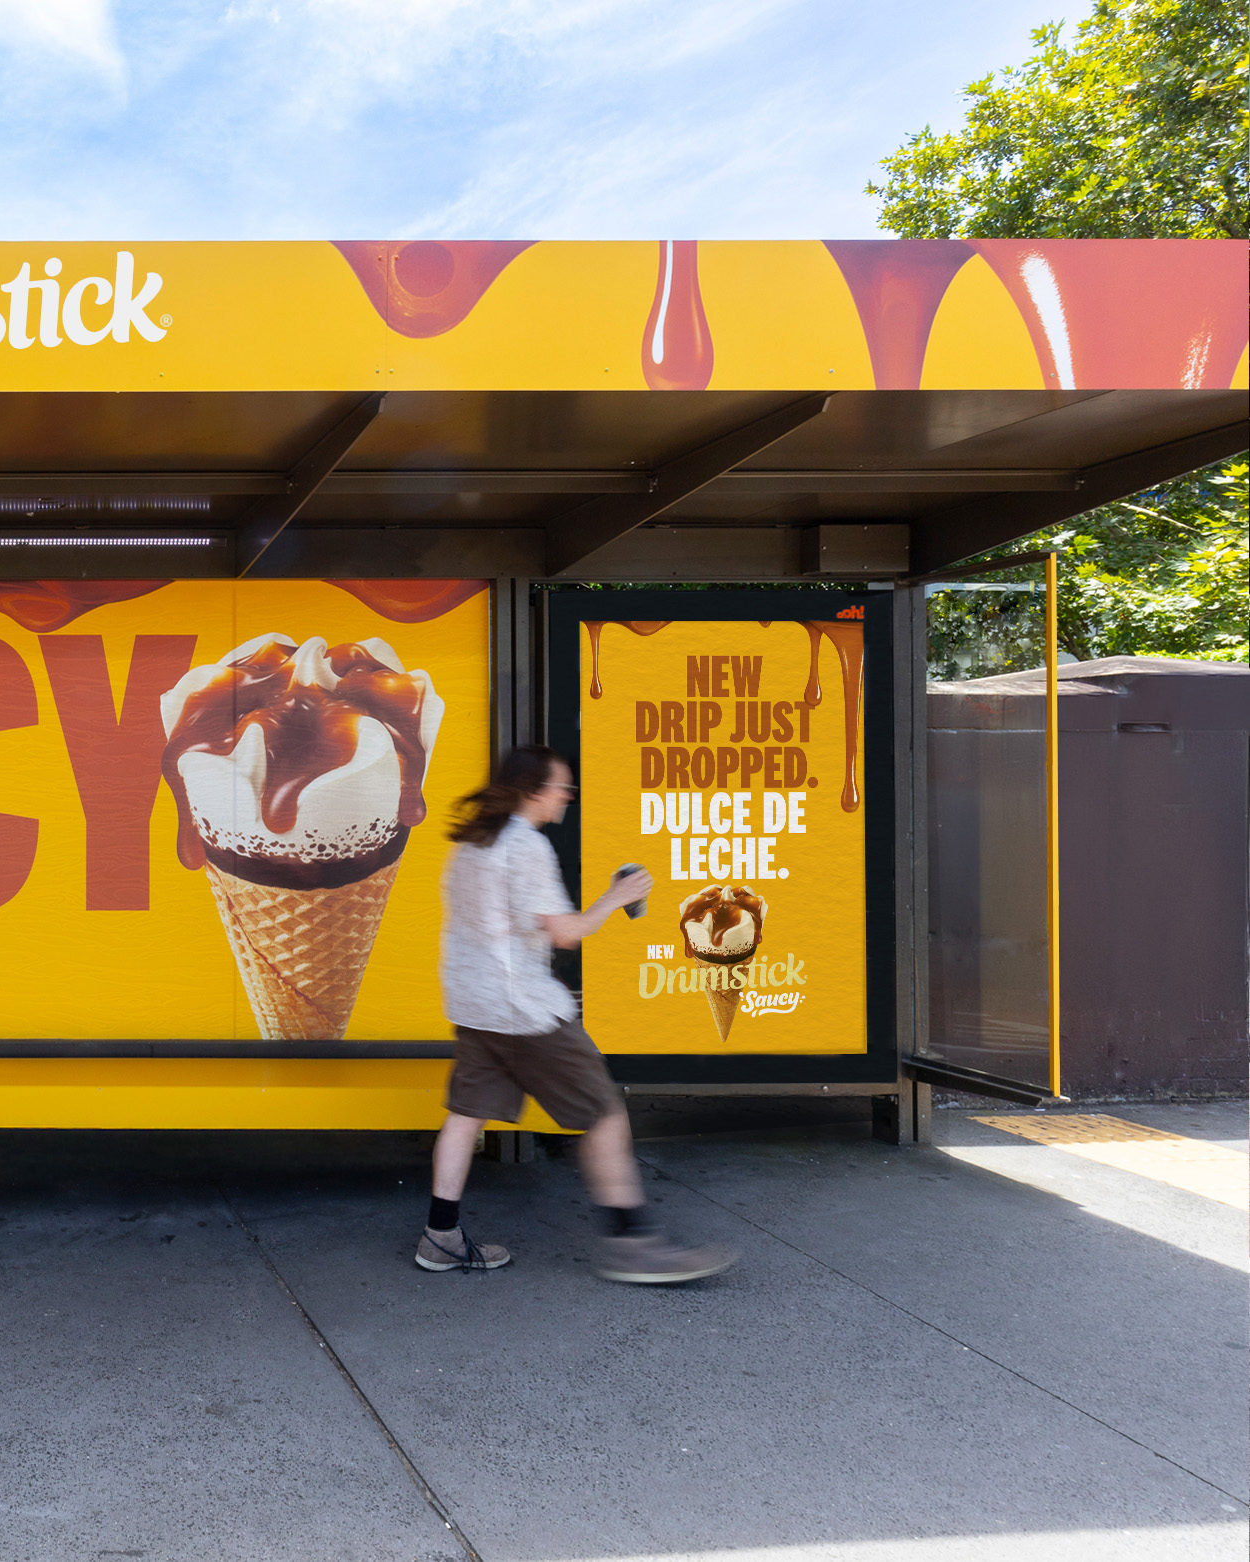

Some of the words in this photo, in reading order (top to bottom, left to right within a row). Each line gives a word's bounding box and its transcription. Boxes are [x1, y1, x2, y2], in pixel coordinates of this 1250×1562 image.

[686, 656, 763, 697] NEW
[635, 701, 722, 743] DRIP
[730, 701, 816, 743] JUST
[641, 746, 818, 788] DROPPED.
[640, 792, 751, 834] DULCE
[763, 792, 807, 834] DE
[670, 837, 789, 880] LECHE.
[647, 944, 674, 960] NEW
[740, 990, 800, 1017] Saucy
